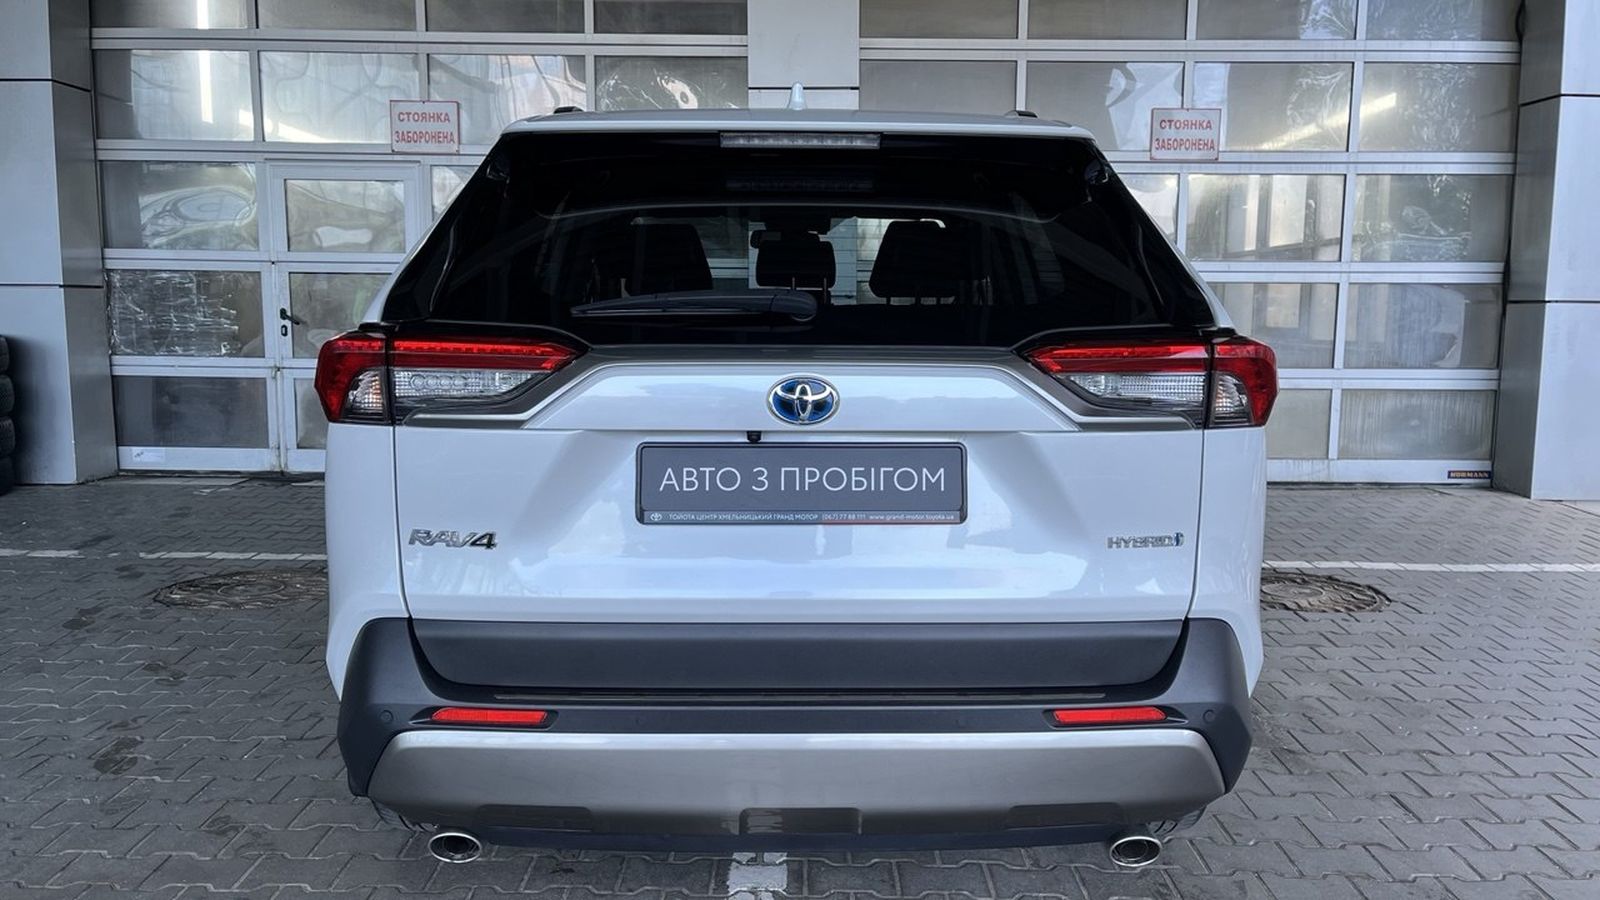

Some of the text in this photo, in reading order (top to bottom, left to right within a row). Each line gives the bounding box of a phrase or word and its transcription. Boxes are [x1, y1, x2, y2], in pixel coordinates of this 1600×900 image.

[398, 112, 450, 122] СТОЯНКА
[1160, 120, 1212, 130] СТОЯНКА
[394, 131, 455, 144] ЗАБОРОНЕНА
[1155, 138, 1215, 151] ЗАБОРОНЕНА
[659, 467, 945, 491] АВТО З ПРОБІГОМ
[795, 512, 818, 521] МОТОР
[408, 529, 497, 550] RAV4
[1107, 535, 1174, 549] HYBRID
